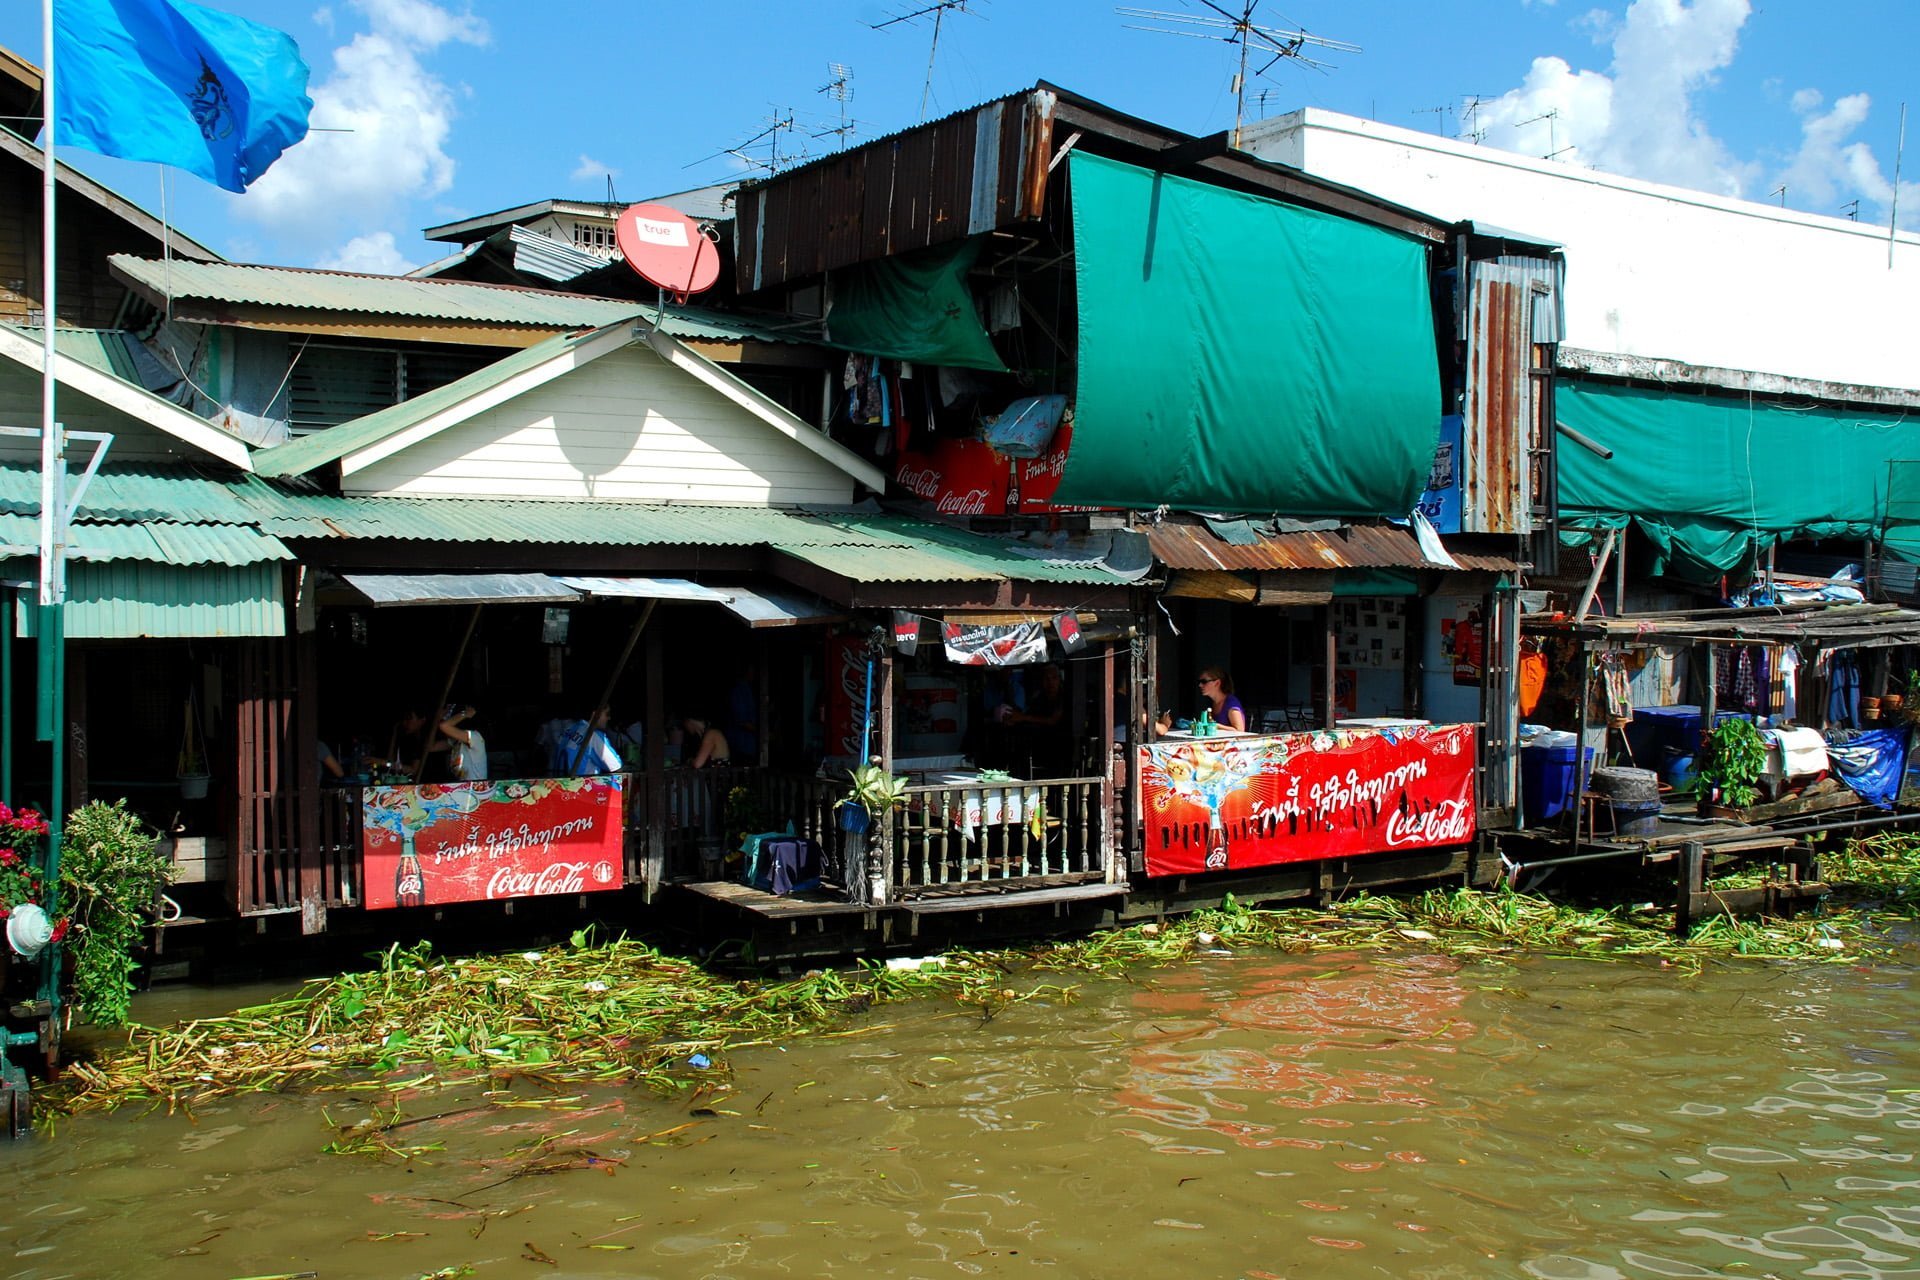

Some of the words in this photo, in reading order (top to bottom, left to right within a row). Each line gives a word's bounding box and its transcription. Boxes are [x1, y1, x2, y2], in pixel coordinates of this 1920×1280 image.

[643, 223, 671, 236] true
[936, 489, 990, 515] Coca-Cola
[896, 632, 916, 642] zero
[486, 862, 589, 899] Coca-Cola
